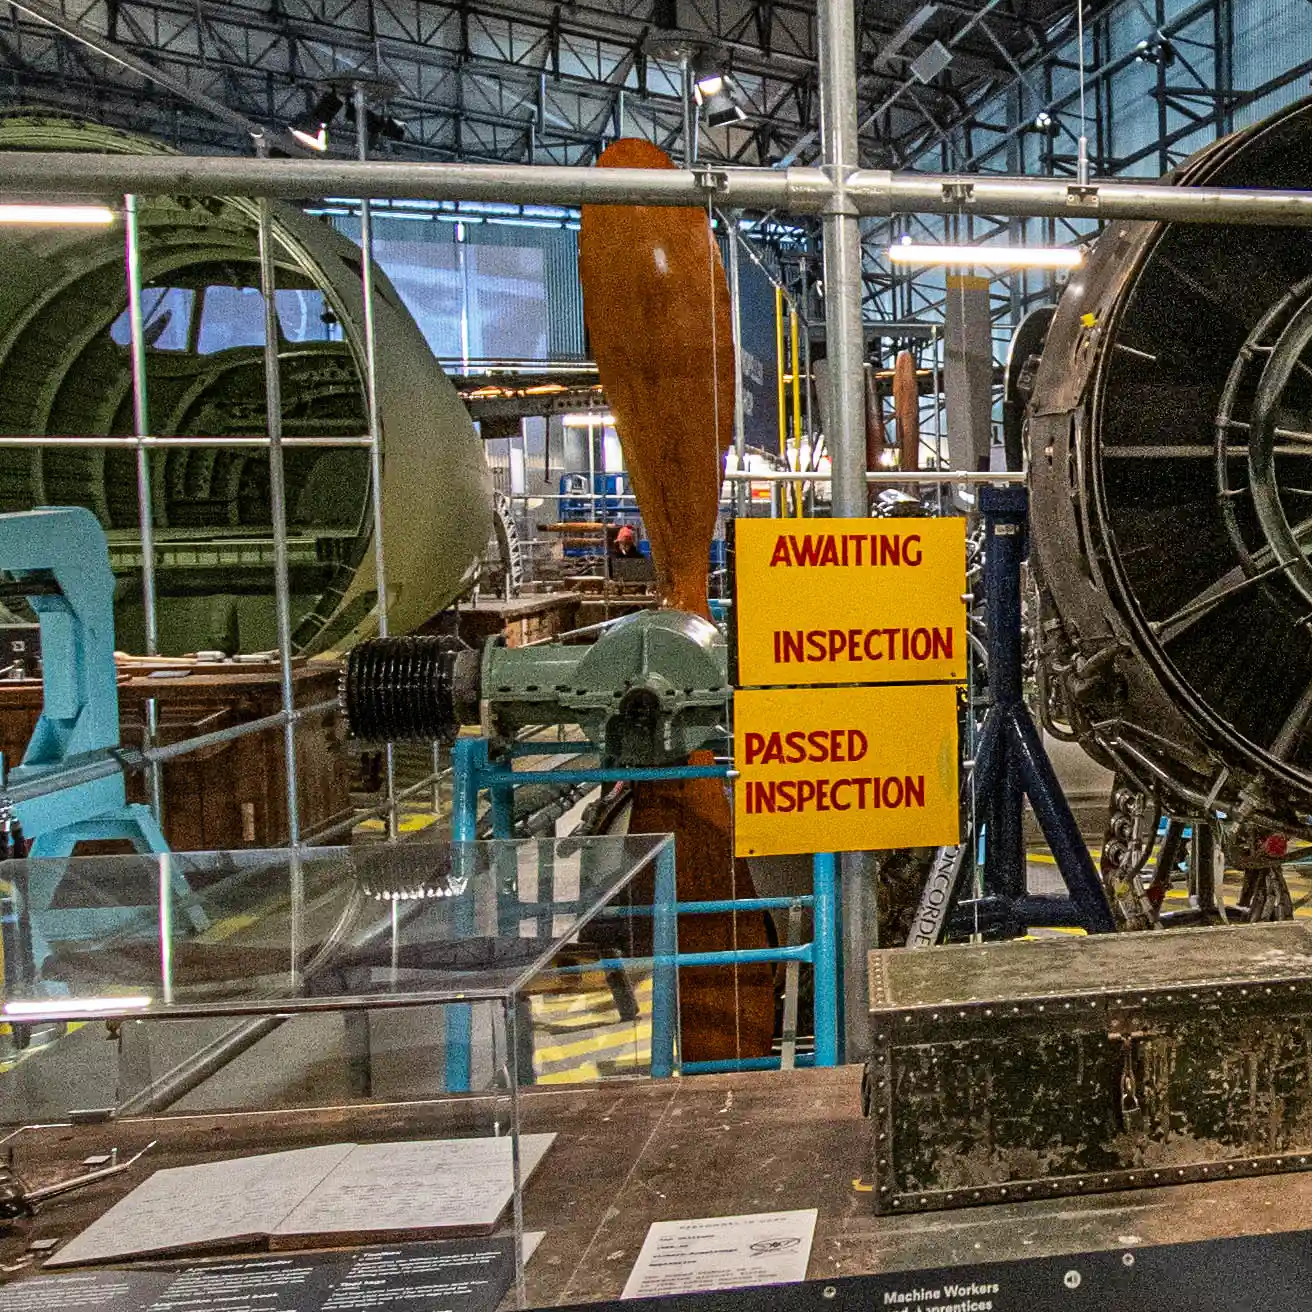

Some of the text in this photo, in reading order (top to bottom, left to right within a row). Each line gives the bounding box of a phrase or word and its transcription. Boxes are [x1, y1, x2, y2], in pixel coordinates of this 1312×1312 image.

[771, 536, 922, 567] AWAITING
[775, 628, 953, 664] INSPECTION
[746, 731, 869, 765] PASSED
[747, 777, 925, 814] INSPECTION
[884, 1282, 999, 1304] Machine Workers
